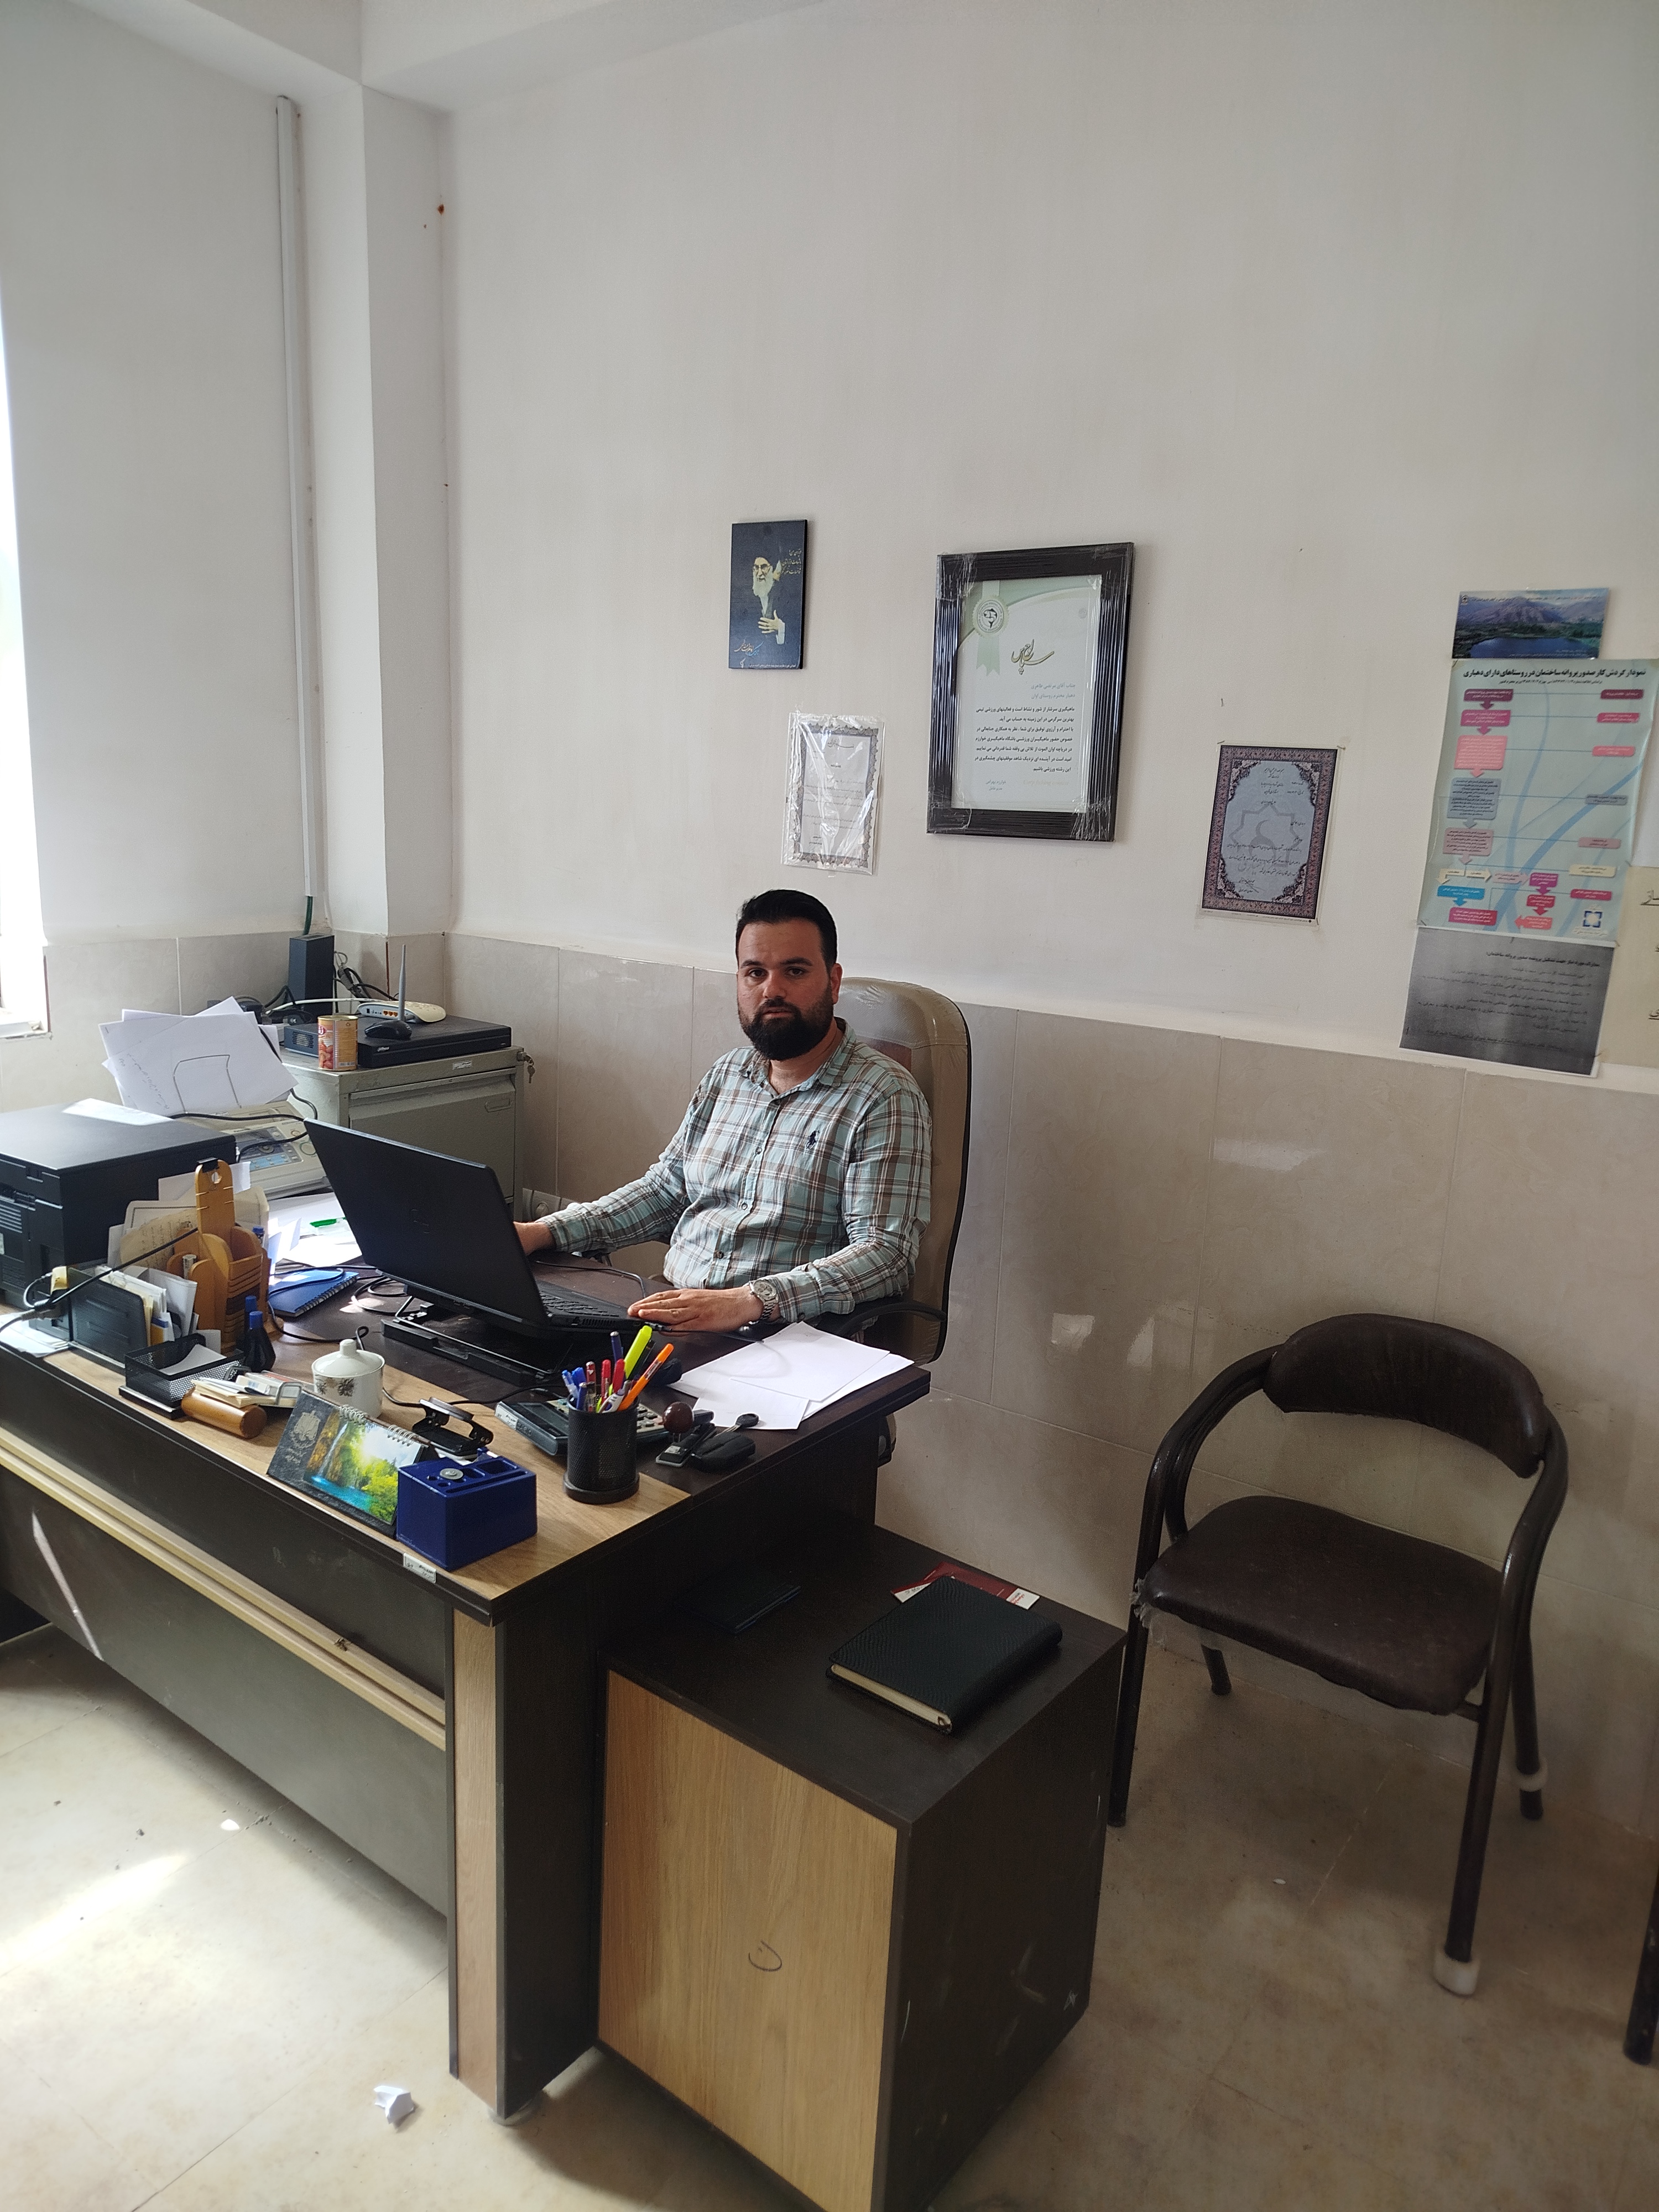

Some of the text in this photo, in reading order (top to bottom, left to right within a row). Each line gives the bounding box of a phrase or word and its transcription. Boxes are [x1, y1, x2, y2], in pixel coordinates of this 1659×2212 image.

[1463, 669, 1483, 677] دهیاری
[1483, 669, 1500, 677] دارای
[1499, 668, 1527, 678] روستاهای
[1535, 668, 1562, 677] ساختمان
[1561, 669, 1578, 677] پروانه
[1595, 669, 1606, 677] کار
[1604, 669, 1626, 678] گردش
[1625, 669, 1646, 677] نمودار
